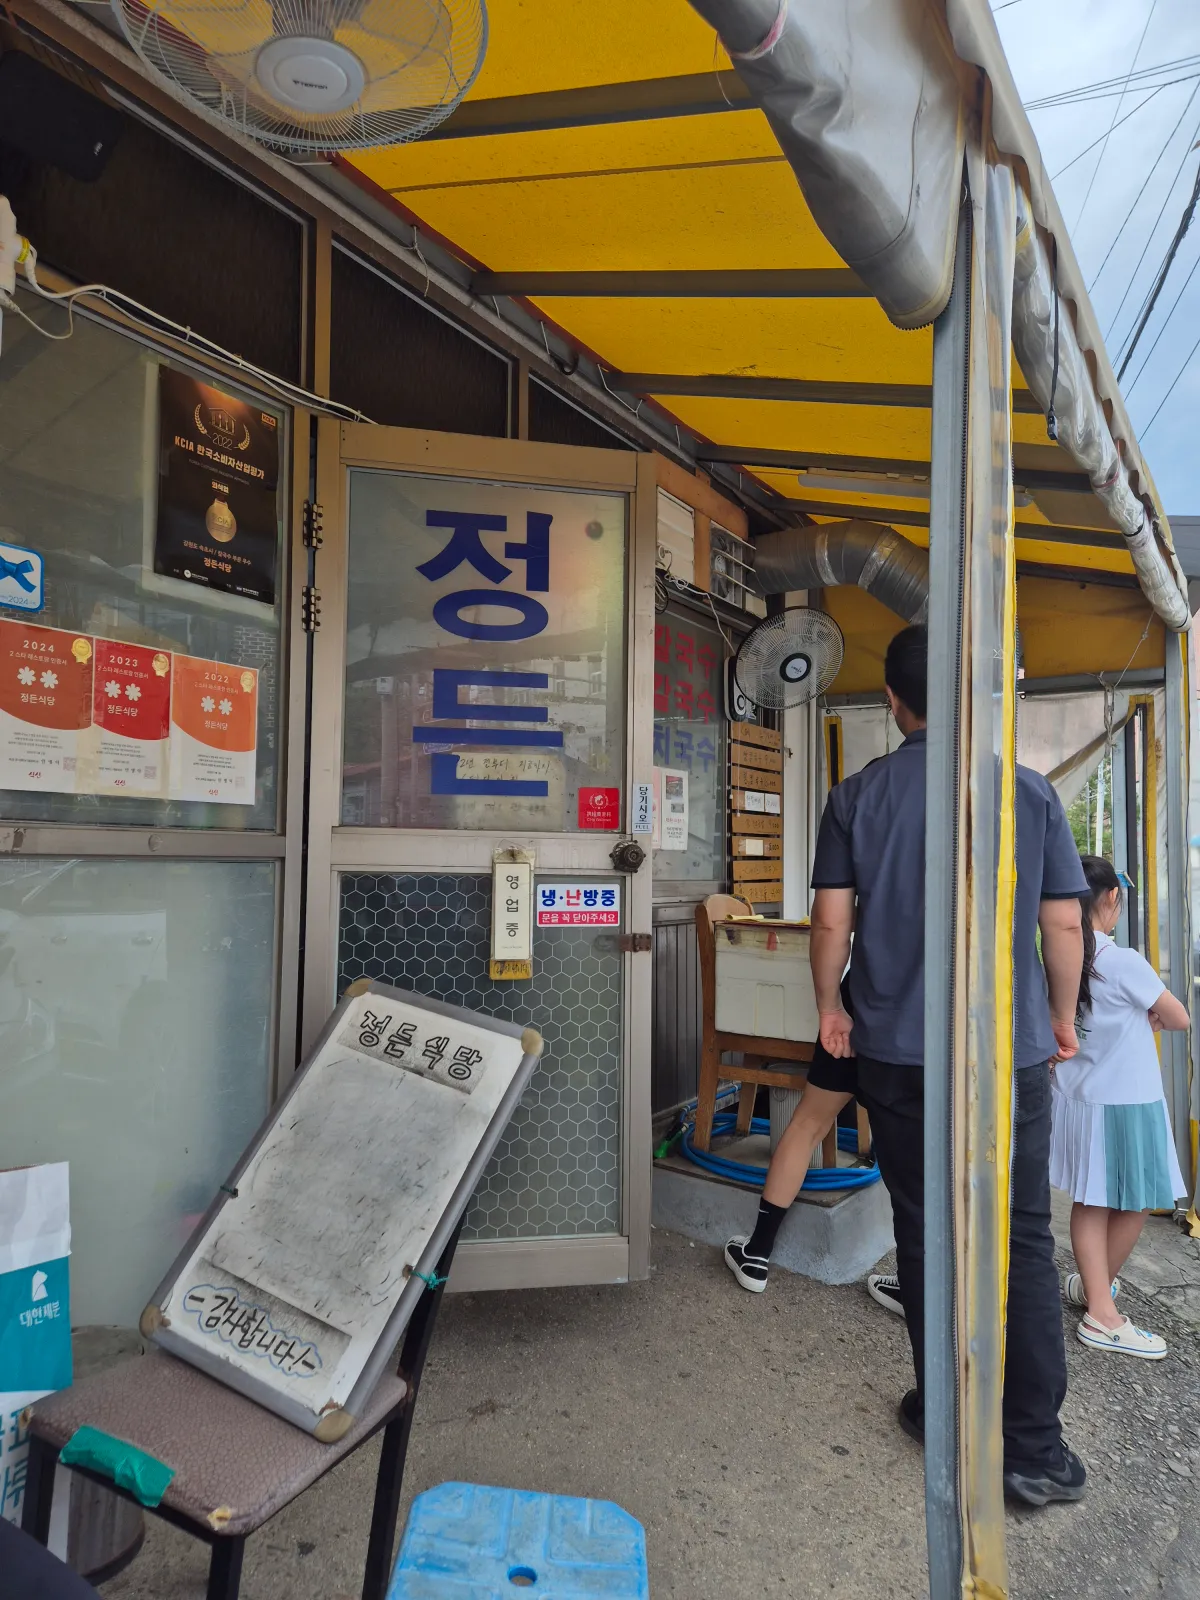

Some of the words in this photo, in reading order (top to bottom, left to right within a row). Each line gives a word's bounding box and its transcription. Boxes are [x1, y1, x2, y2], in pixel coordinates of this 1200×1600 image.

[212, 432, 232, 450] 2022
[174, 436, 194, 452] KCIA
[197, 444, 265, 480] 한국소비자산업평가
[203, 557, 232, 573] 정든식당
[23, 640, 54, 653] 2024
[412, 510, 563, 797] 정든
[109, 655, 138, 667] 2023
[204, 672, 229, 683] 2022
[20, 693, 55, 705] 정든식당
[107, 704, 138, 717] 정든식당
[204, 720, 228, 731] 정든식당
[639, 786, 649, 822] 당기시오
[505, 875, 519, 937] 영업중
[541, 913, 559, 923] 문을
[561, 914, 570, 922] 꼭
[573, 913, 616, 923] 닫아주세요
